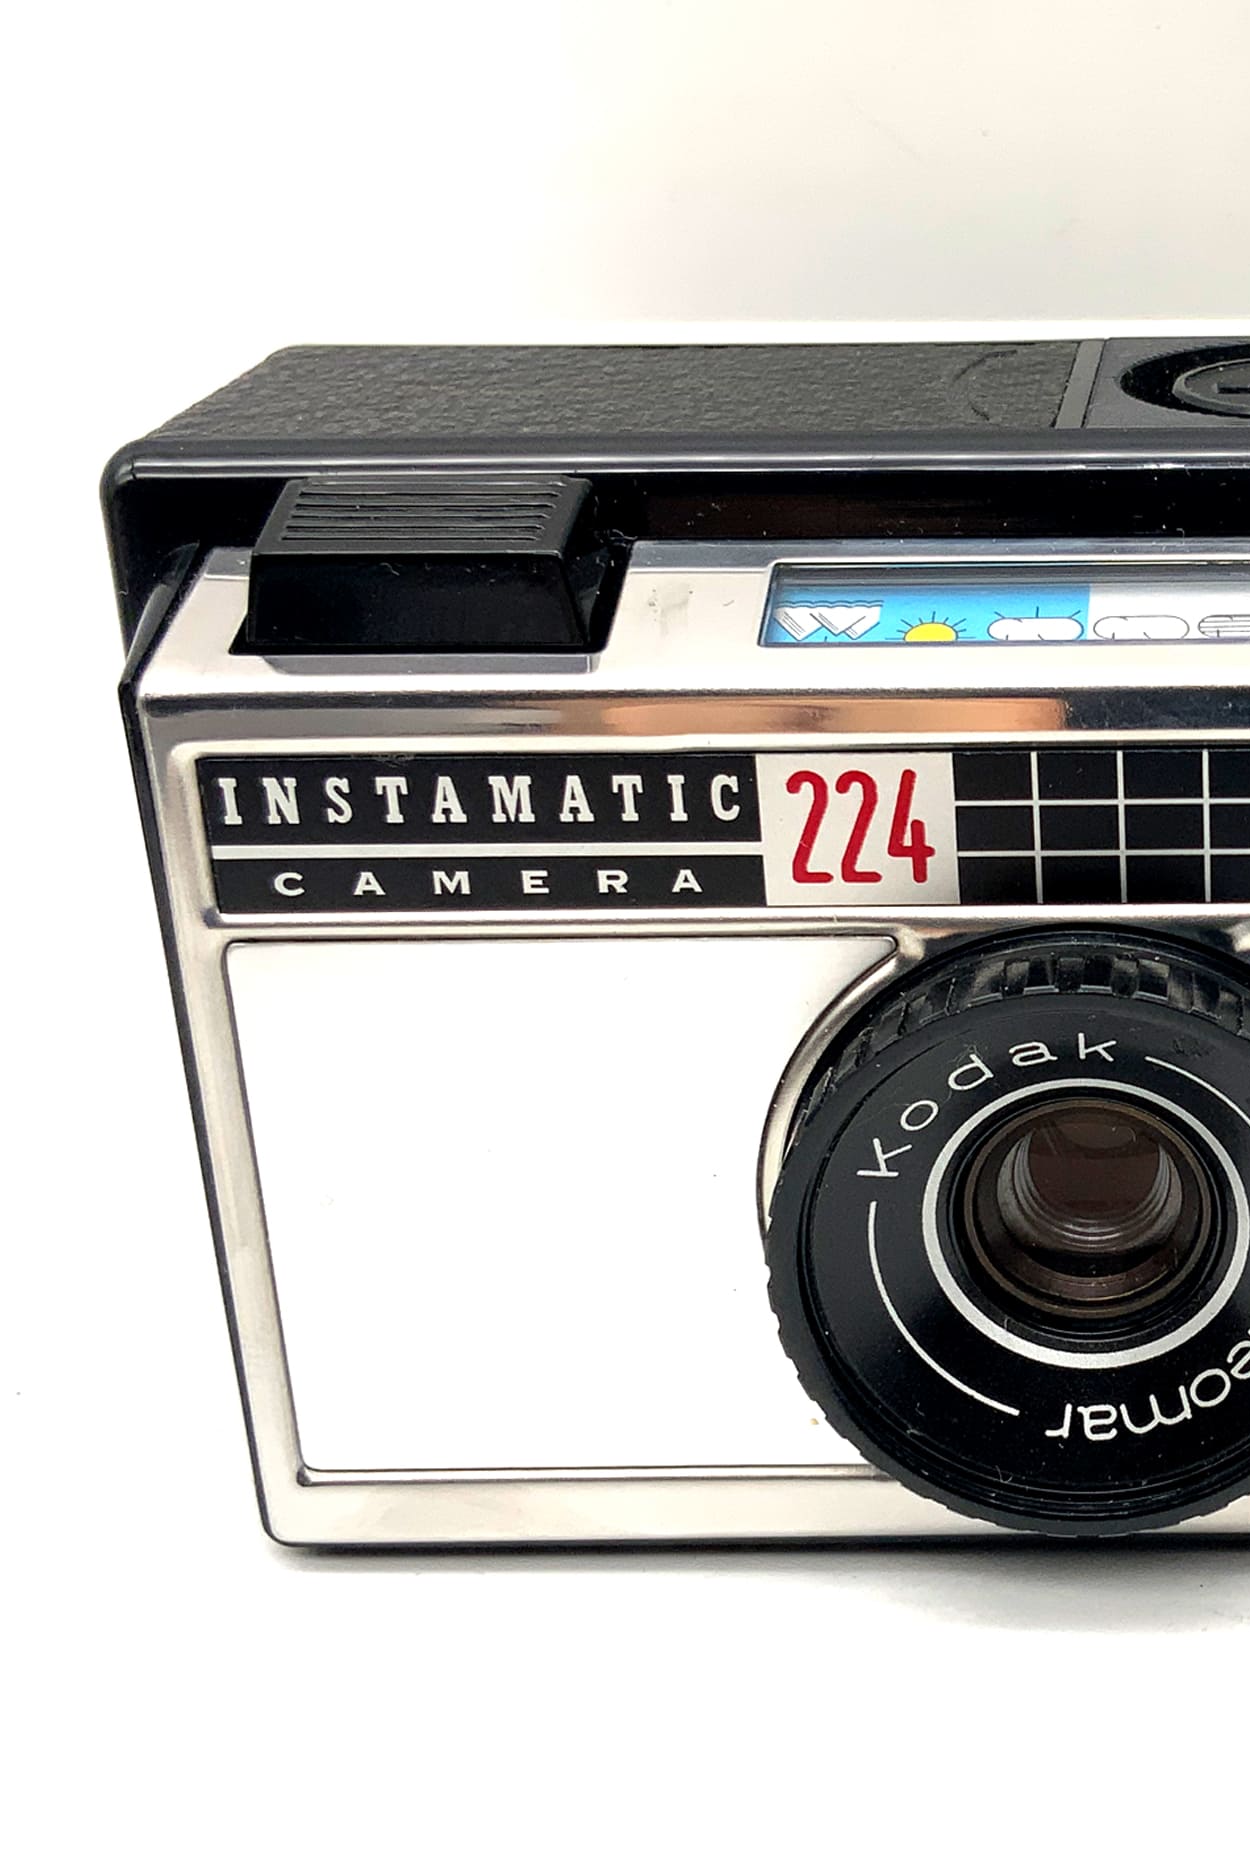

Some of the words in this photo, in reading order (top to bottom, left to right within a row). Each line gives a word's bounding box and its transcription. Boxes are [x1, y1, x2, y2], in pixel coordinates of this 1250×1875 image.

[217, 773, 743, 827] INSTAMATIC
[784, 767, 937, 885] 224
[273, 868, 704, 898] CAMERA
[857, 1032, 1118, 1179] Kodak
